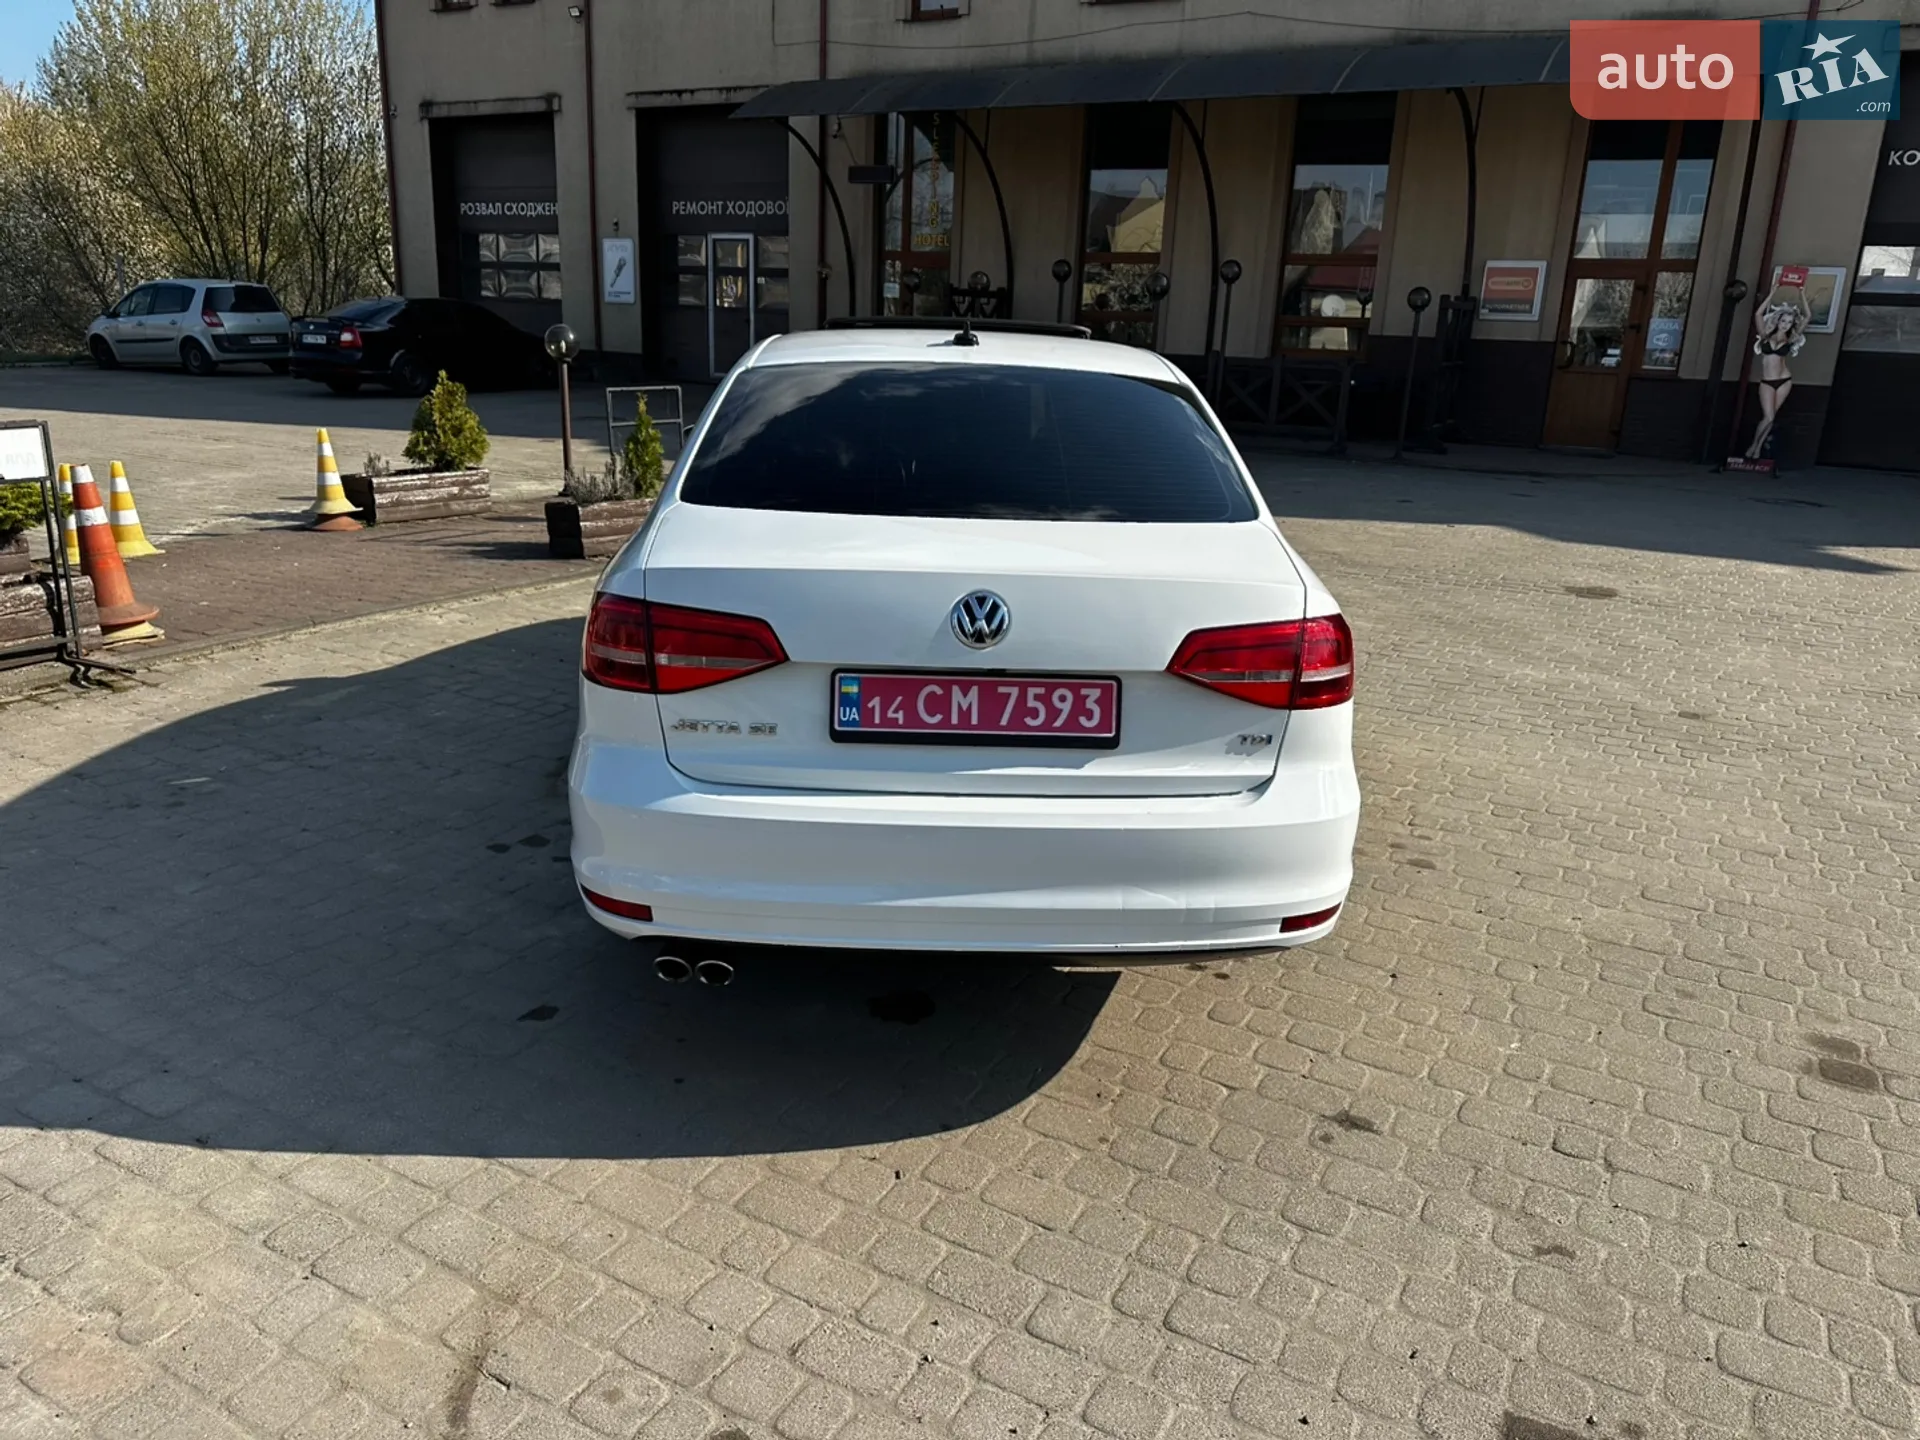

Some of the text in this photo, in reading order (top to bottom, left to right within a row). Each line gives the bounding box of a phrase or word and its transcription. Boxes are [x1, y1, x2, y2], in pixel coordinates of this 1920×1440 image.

[460, 202, 503, 215] РОЗВАЛ
[672, 200, 724, 215] РЕМОНТ
[913, 234, 950, 246] HOTEL
[840, 706, 860, 721] UA
[867, 684, 1102, 728] 14 CM 7593
[670, 718, 742, 735] JETTA
[1237, 734, 1273, 747] TDI
